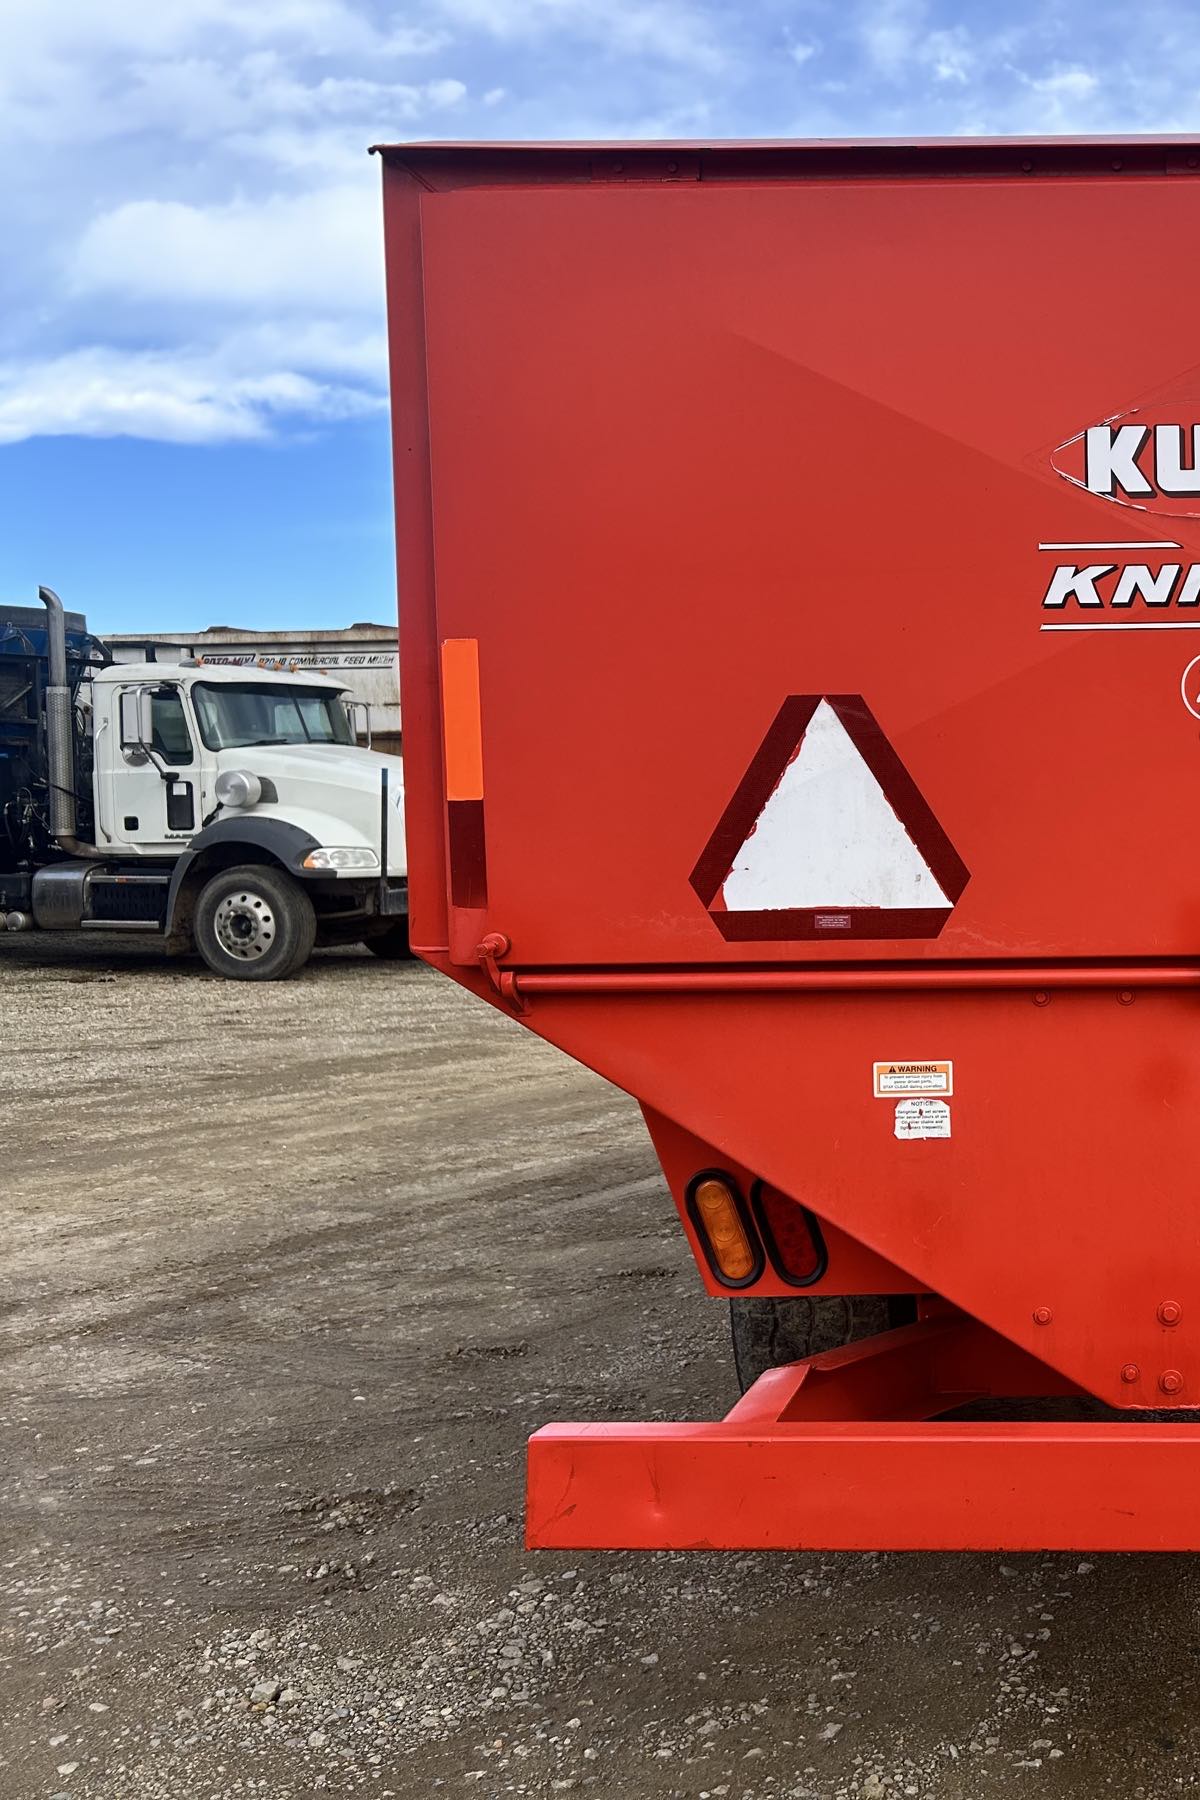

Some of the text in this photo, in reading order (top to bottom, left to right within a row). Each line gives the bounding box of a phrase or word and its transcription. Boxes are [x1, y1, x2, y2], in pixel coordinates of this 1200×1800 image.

[289, 656, 340, 665] COMMERCIAL
[344, 656, 365, 664] FEED
[367, 656, 394, 664] MIXER
